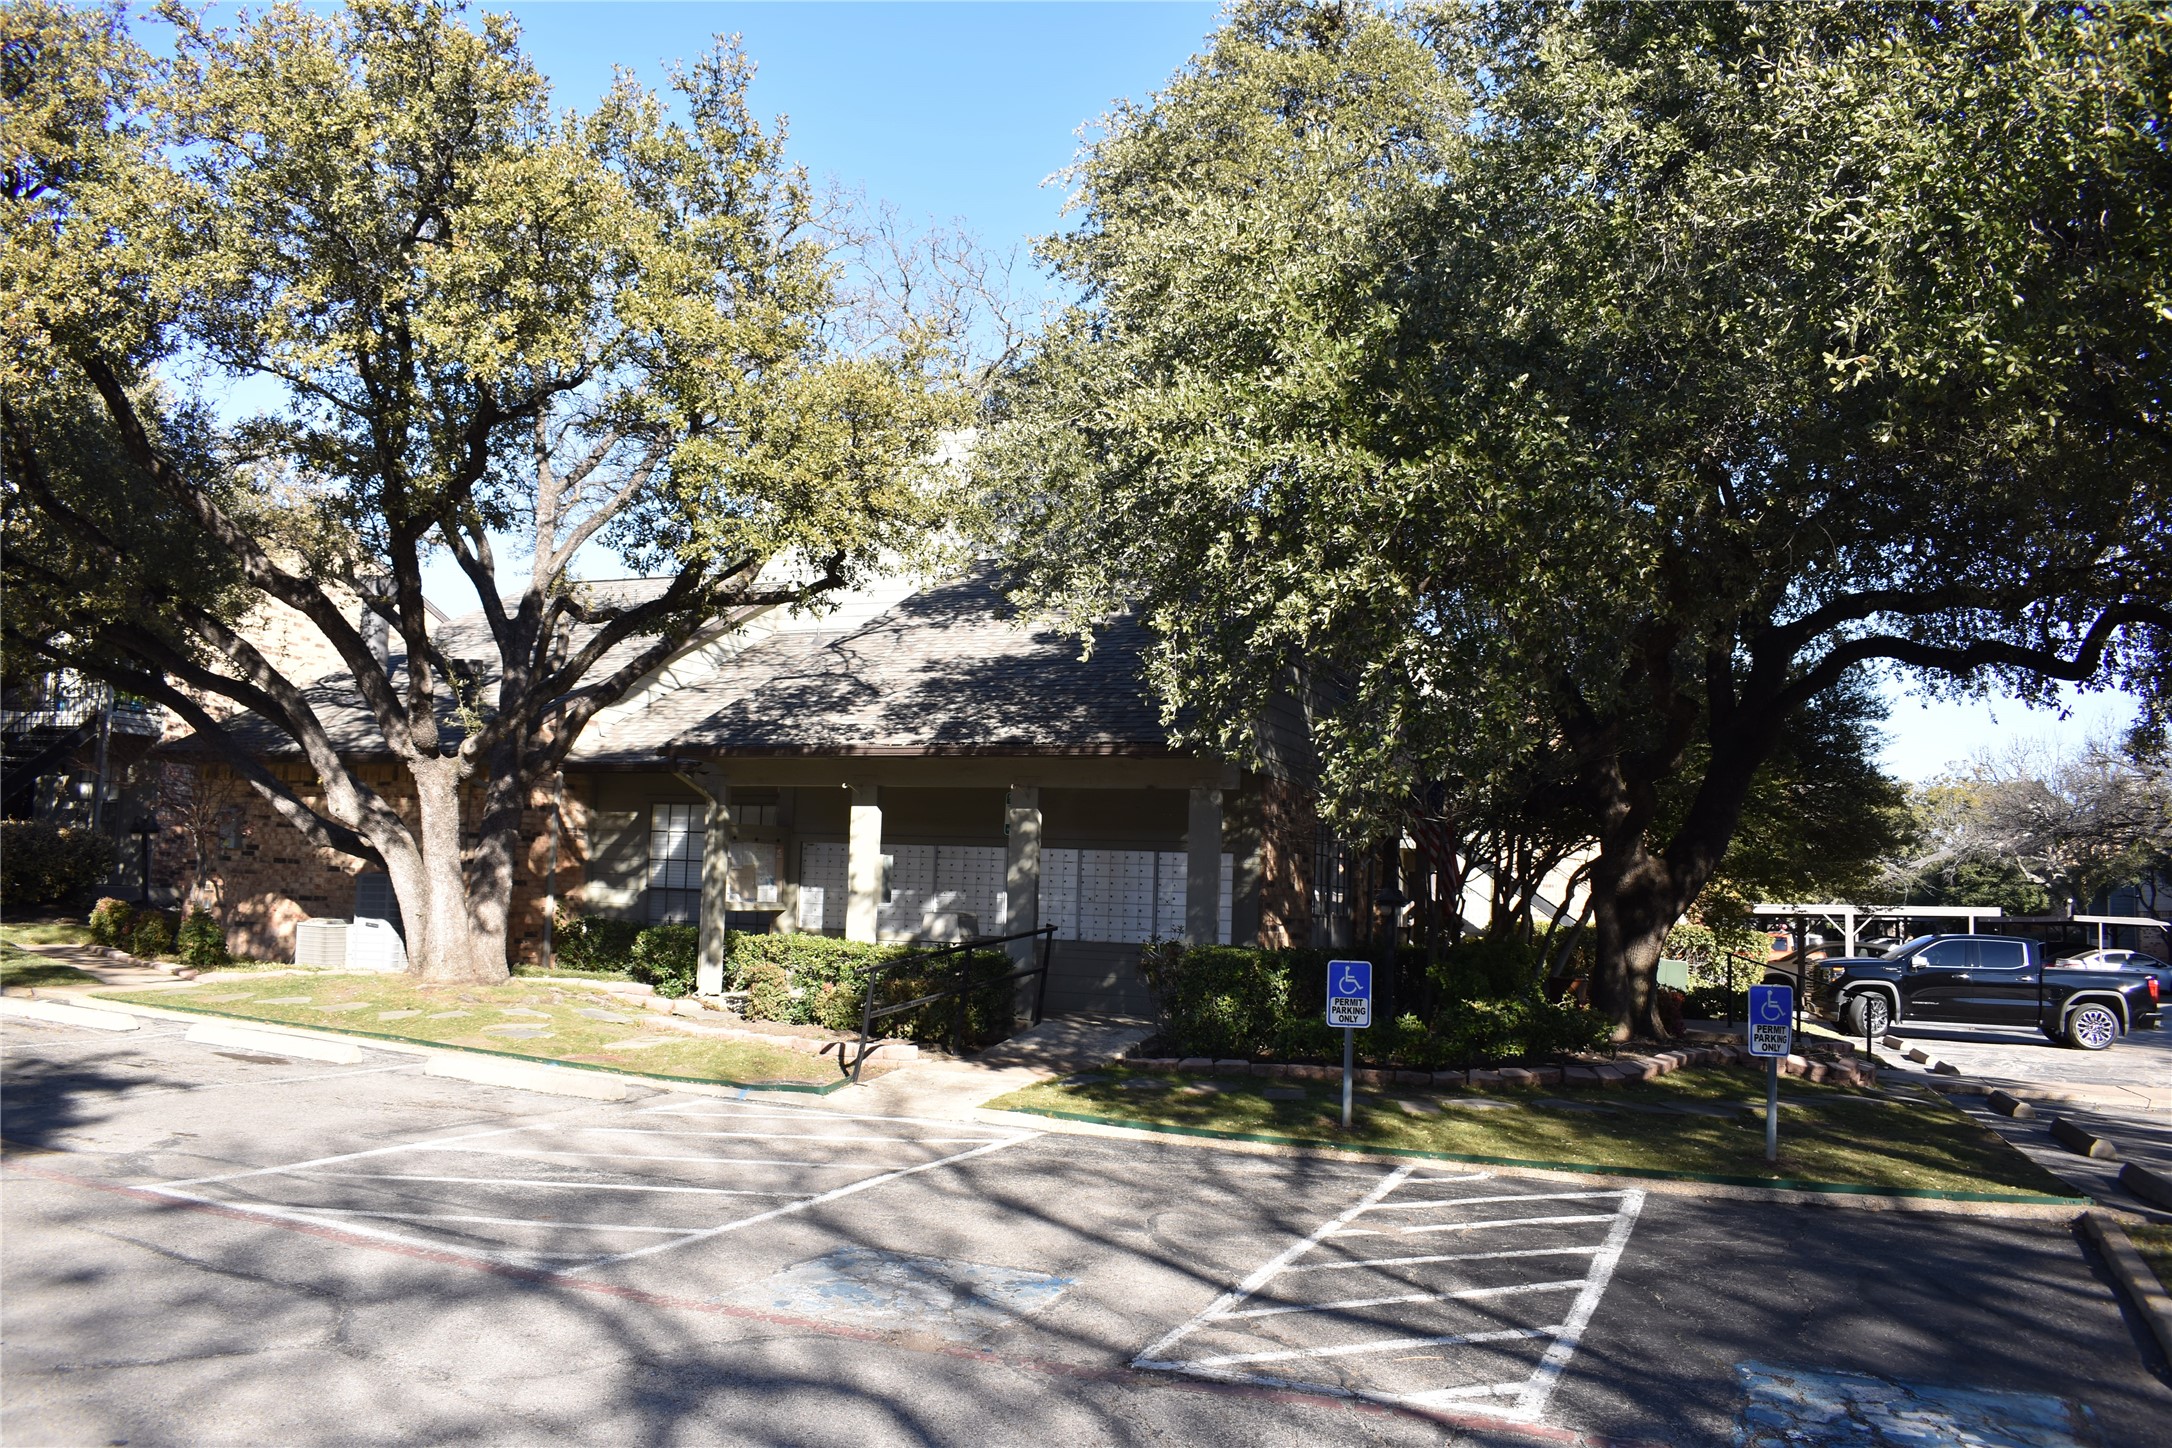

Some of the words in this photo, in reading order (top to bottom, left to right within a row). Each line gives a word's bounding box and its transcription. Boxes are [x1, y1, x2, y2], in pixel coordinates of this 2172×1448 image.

[1334, 998, 1363, 1006] PERMIT
[1331, 1006, 1366, 1015] PARKING
[1338, 1015, 1358, 1023] ONLY
[1757, 1025, 1786, 1034] PERMIT
[1754, 1034, 1787, 1043] PARKING
[1762, 1043, 1781, 1052] ONLY
